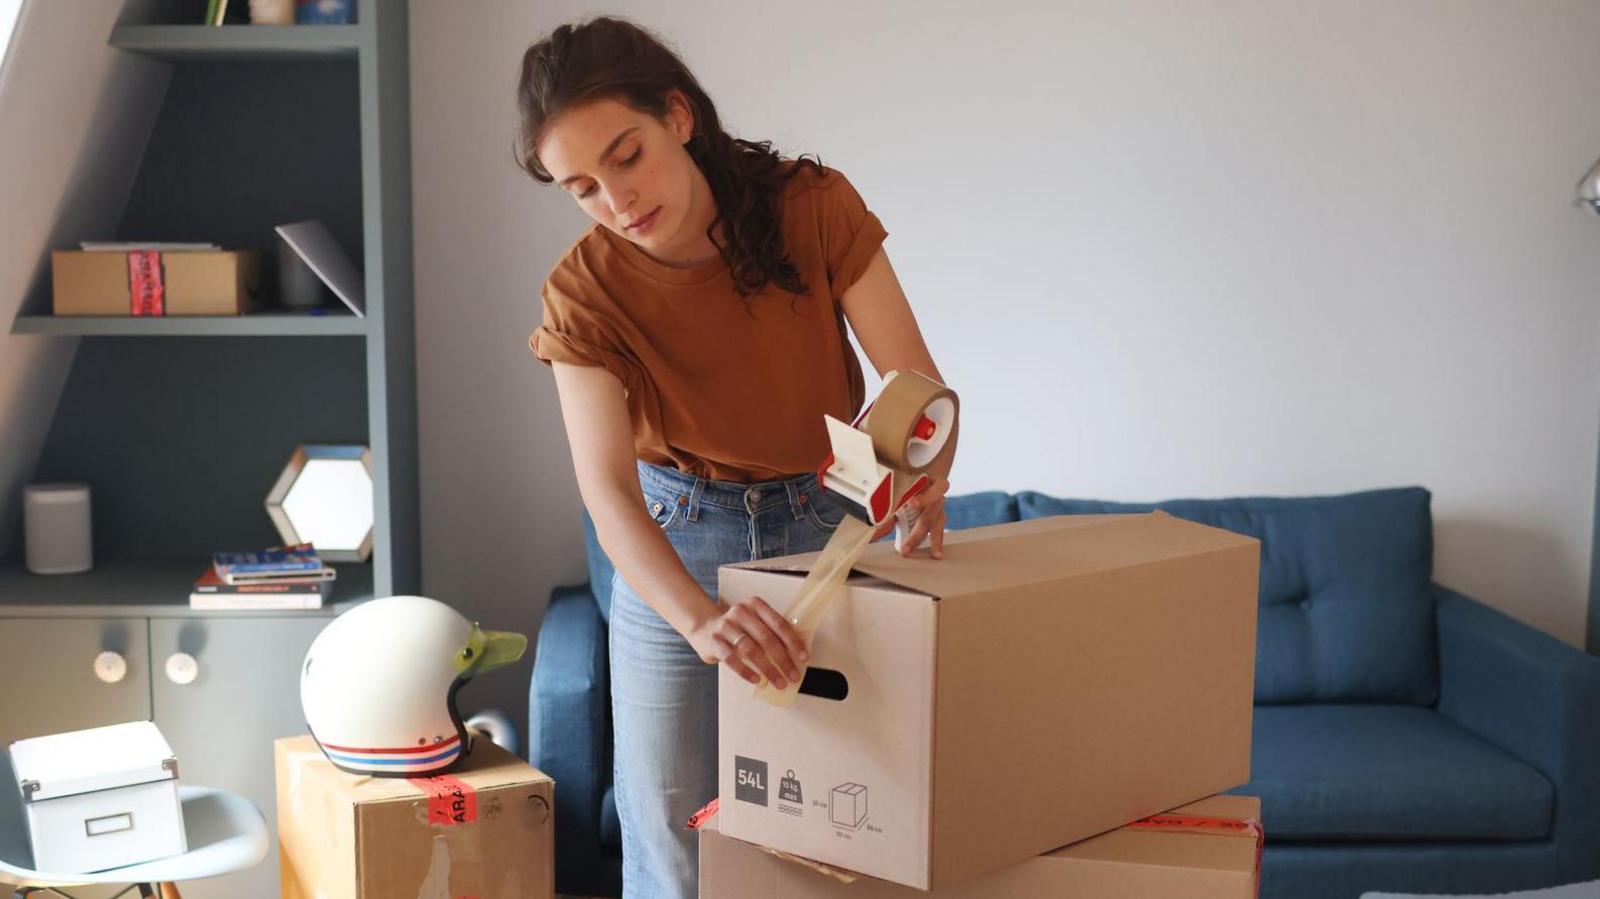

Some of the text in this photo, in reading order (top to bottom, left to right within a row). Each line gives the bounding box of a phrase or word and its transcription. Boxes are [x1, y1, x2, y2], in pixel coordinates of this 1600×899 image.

[737, 768, 765, 790] 54L
[782, 780, 799, 792] 15 kg
[784, 791, 798, 801] max
